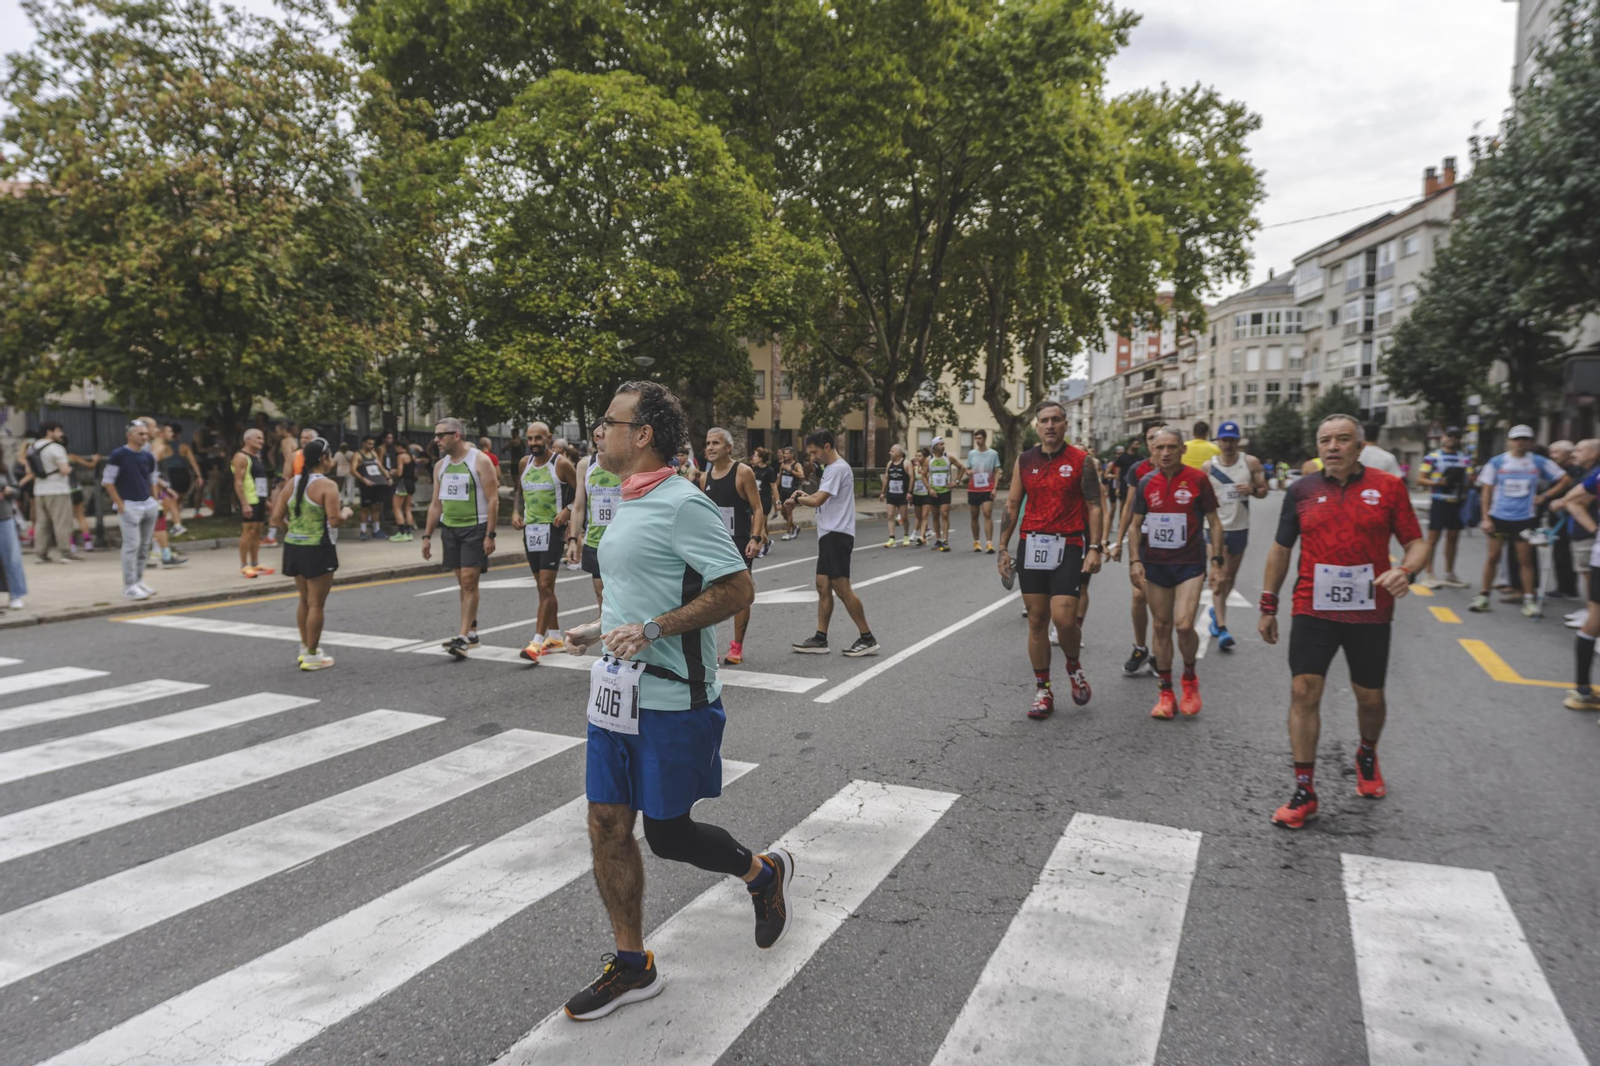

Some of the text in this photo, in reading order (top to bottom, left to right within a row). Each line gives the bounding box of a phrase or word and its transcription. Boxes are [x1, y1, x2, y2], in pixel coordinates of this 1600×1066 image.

[447, 484, 458, 495] 69
[599, 509, 611, 520] 89
[1154, 529, 1174, 542] 492
[1034, 550, 1048, 563] 60
[1331, 586, 1353, 602] 63
[595, 686, 621, 718] 406
